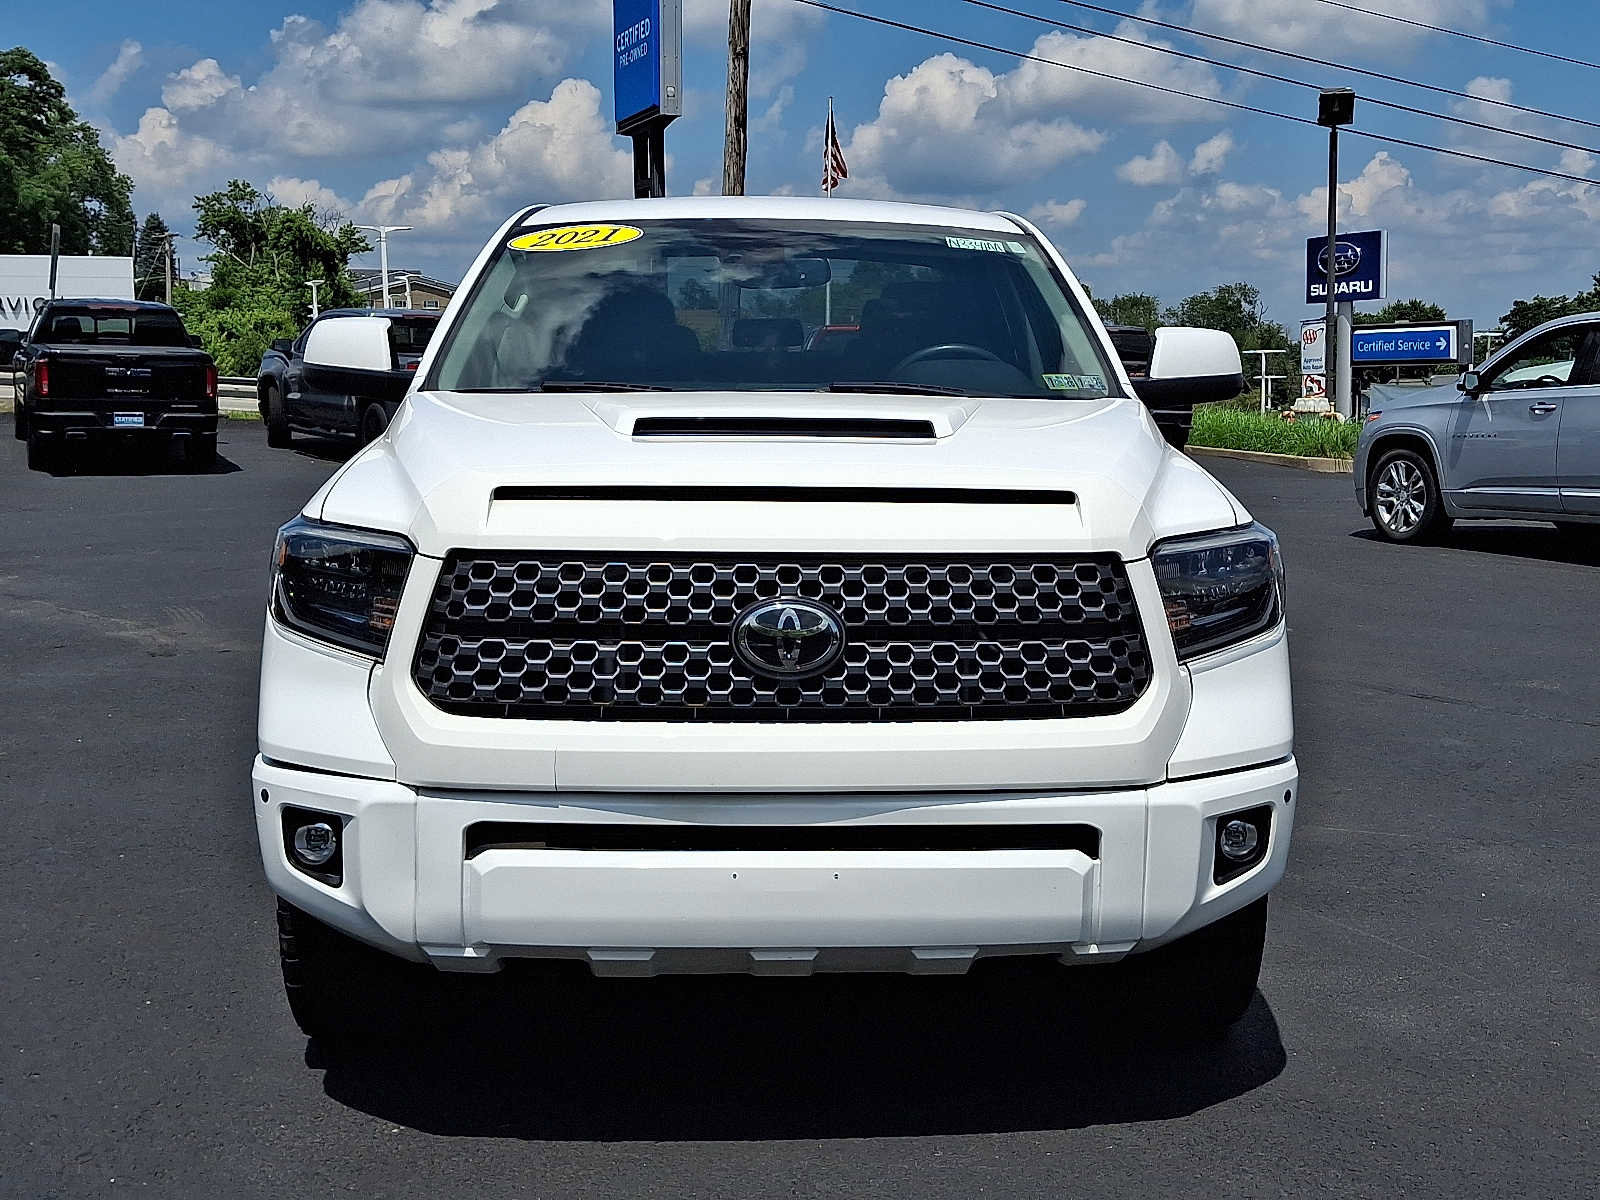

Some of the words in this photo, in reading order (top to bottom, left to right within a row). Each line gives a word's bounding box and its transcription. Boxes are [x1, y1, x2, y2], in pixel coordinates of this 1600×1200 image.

[616, 17, 651, 53] CERTIFIED
[619, 42, 648, 69] PRE-OWNED
[529, 227, 621, 248] 2021
[1357, 339, 1395, 352] Certified
[1398, 339, 1431, 351] Service
